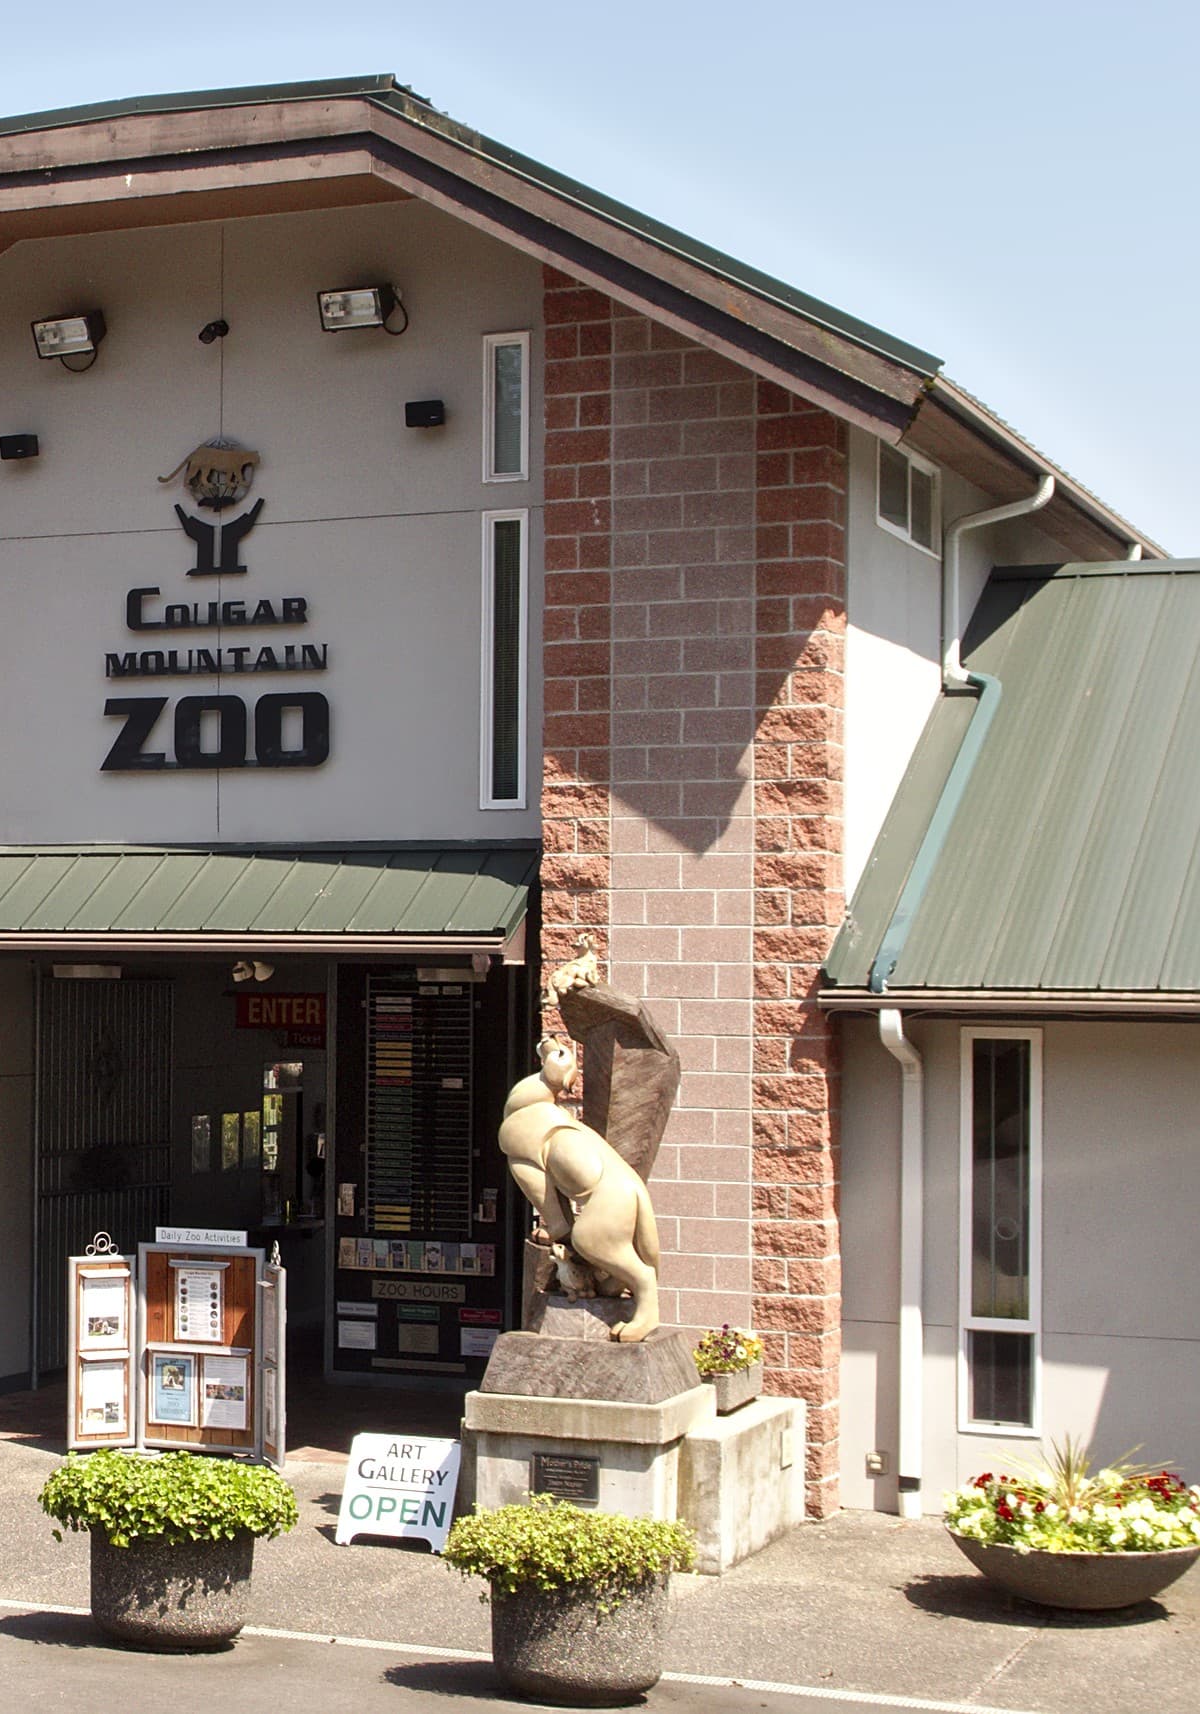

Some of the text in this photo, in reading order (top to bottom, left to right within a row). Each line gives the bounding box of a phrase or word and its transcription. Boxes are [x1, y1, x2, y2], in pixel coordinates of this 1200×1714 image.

[126, 586, 308, 632] COUGAR
[104, 643, 329, 678] MOUNTAIN
[100, 691, 330, 771] ZOO
[247, 997, 320, 1025] ENTER
[161, 1230, 241, 1243] Daily Zoo Activities
[377, 1282, 459, 1299] ZOO HOURS
[387, 1443, 426, 1460] ART
[357, 1458, 449, 1486] GALLERY
[349, 1494, 446, 1528] OPEN
